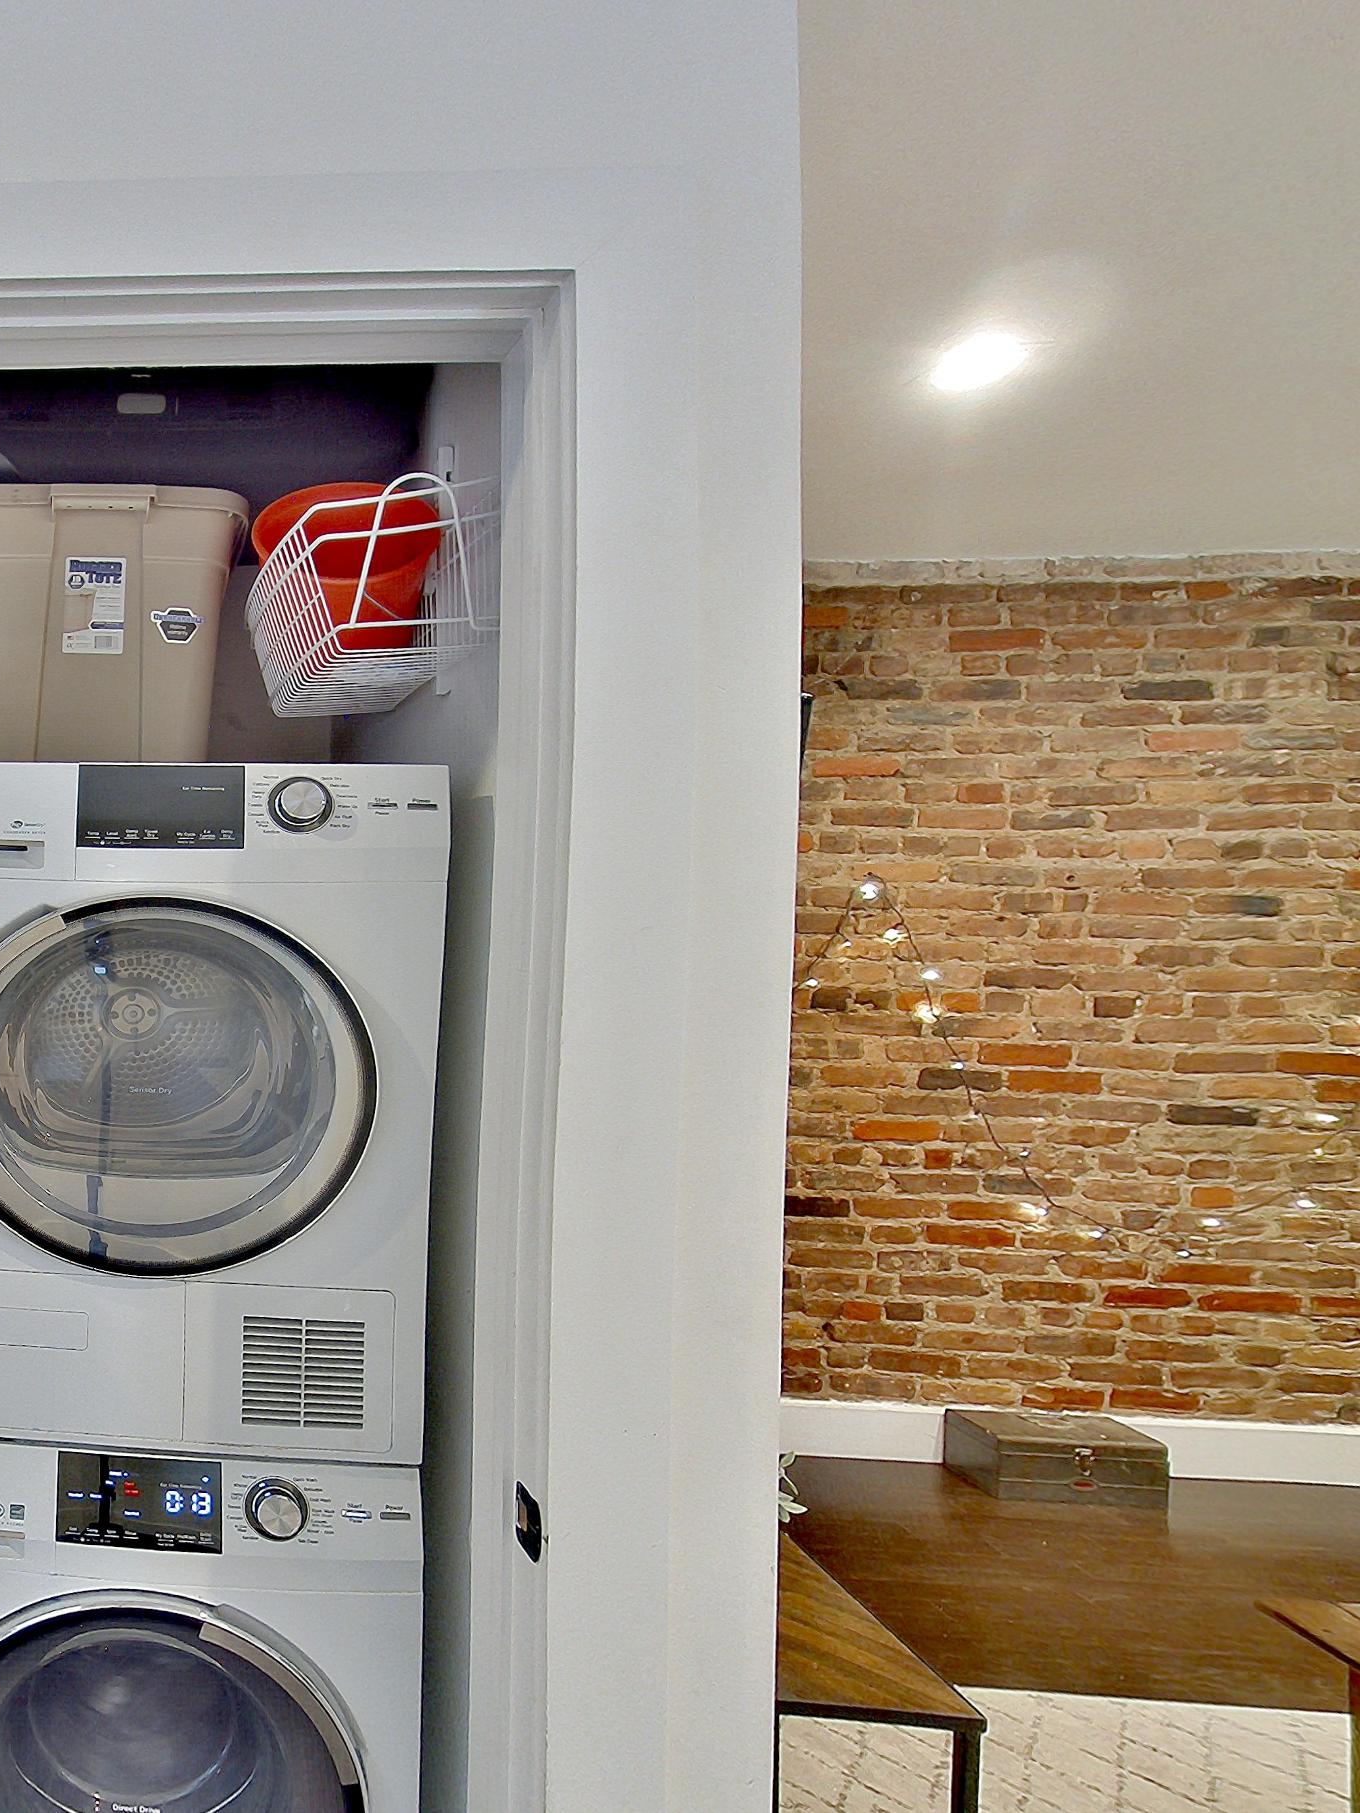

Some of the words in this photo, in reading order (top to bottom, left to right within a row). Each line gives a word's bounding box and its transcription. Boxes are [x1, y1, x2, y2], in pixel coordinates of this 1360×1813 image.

[129, 1086, 156, 1094] Sensor
[158, 1087, 173, 1095] Dry
[112, 1803, 137, 1813] Direct
